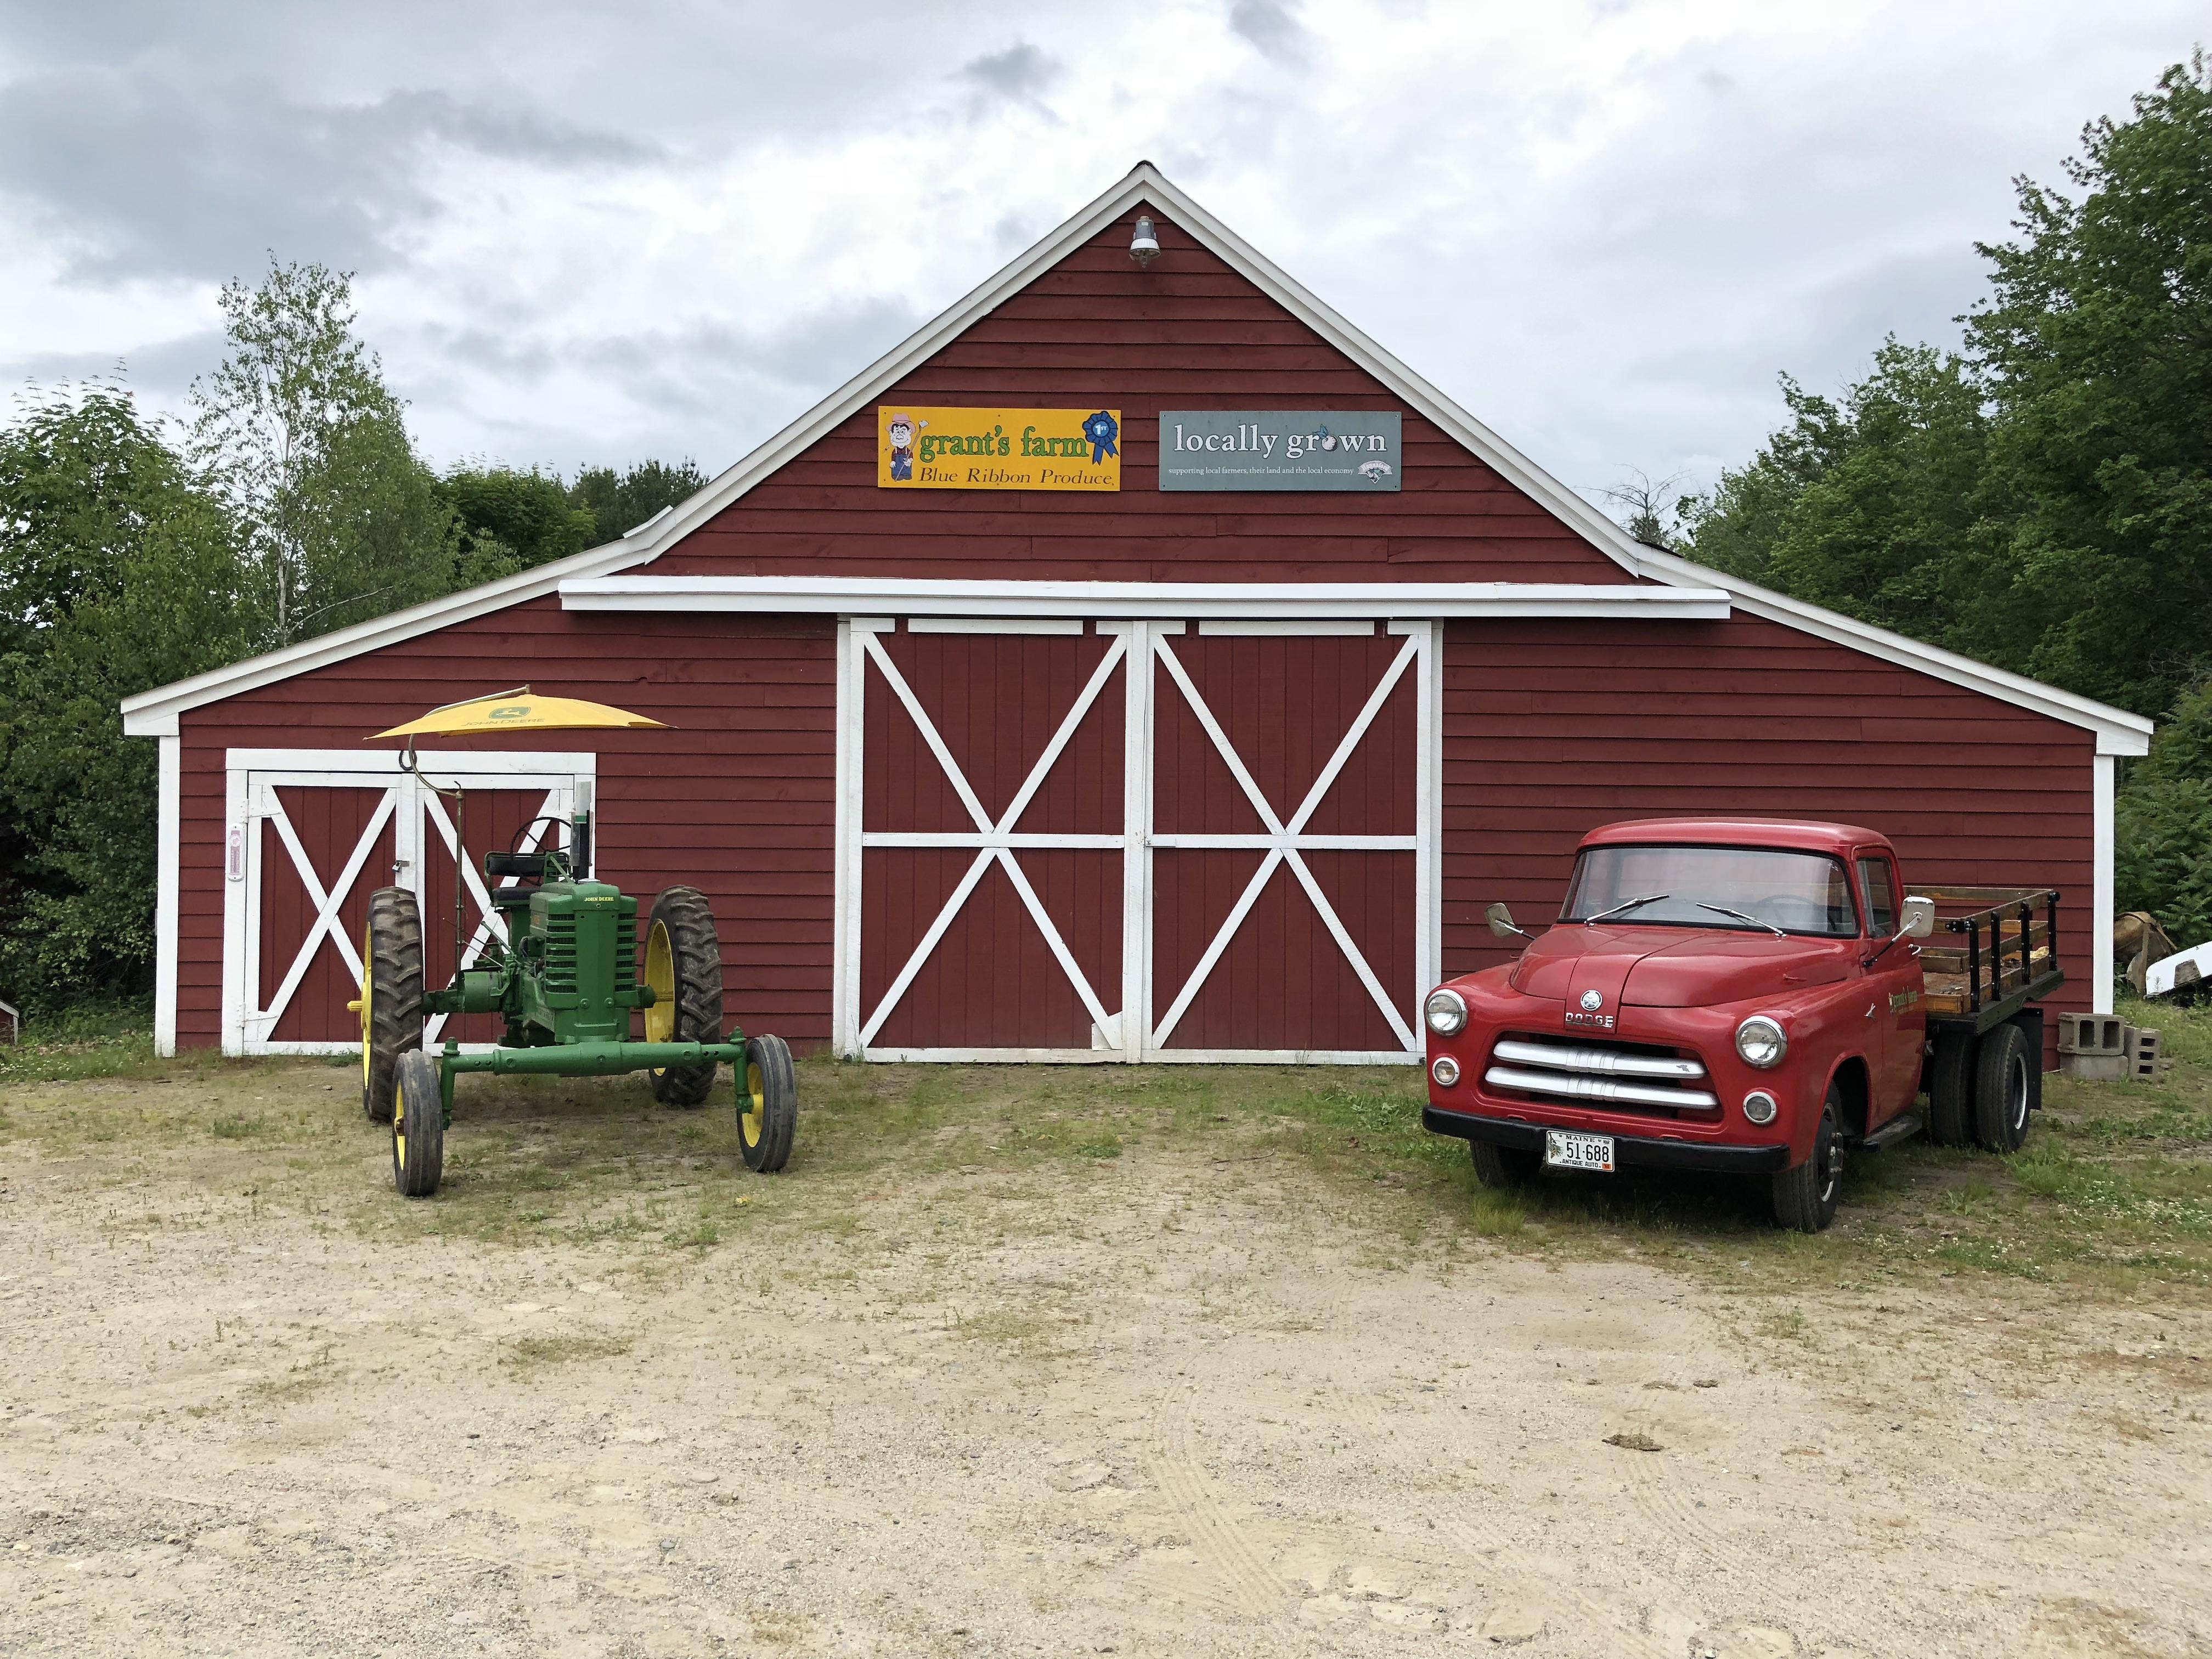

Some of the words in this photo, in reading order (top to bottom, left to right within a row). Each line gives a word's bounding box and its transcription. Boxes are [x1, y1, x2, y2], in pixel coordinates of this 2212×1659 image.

[920, 425, 1011, 462] grant's
[1020, 426, 1090, 457] farm
[1173, 424, 1278, 459] locally
[1285, 433, 1387, 459] grown
[919, 467, 958, 482] Blue
[967, 468, 1030, 483] Ribbon
[1168, 467, 1204, 476] supporting
[1222, 466, 1248, 475] farmers,
[1565, 1012, 1613, 1028] DODGE
